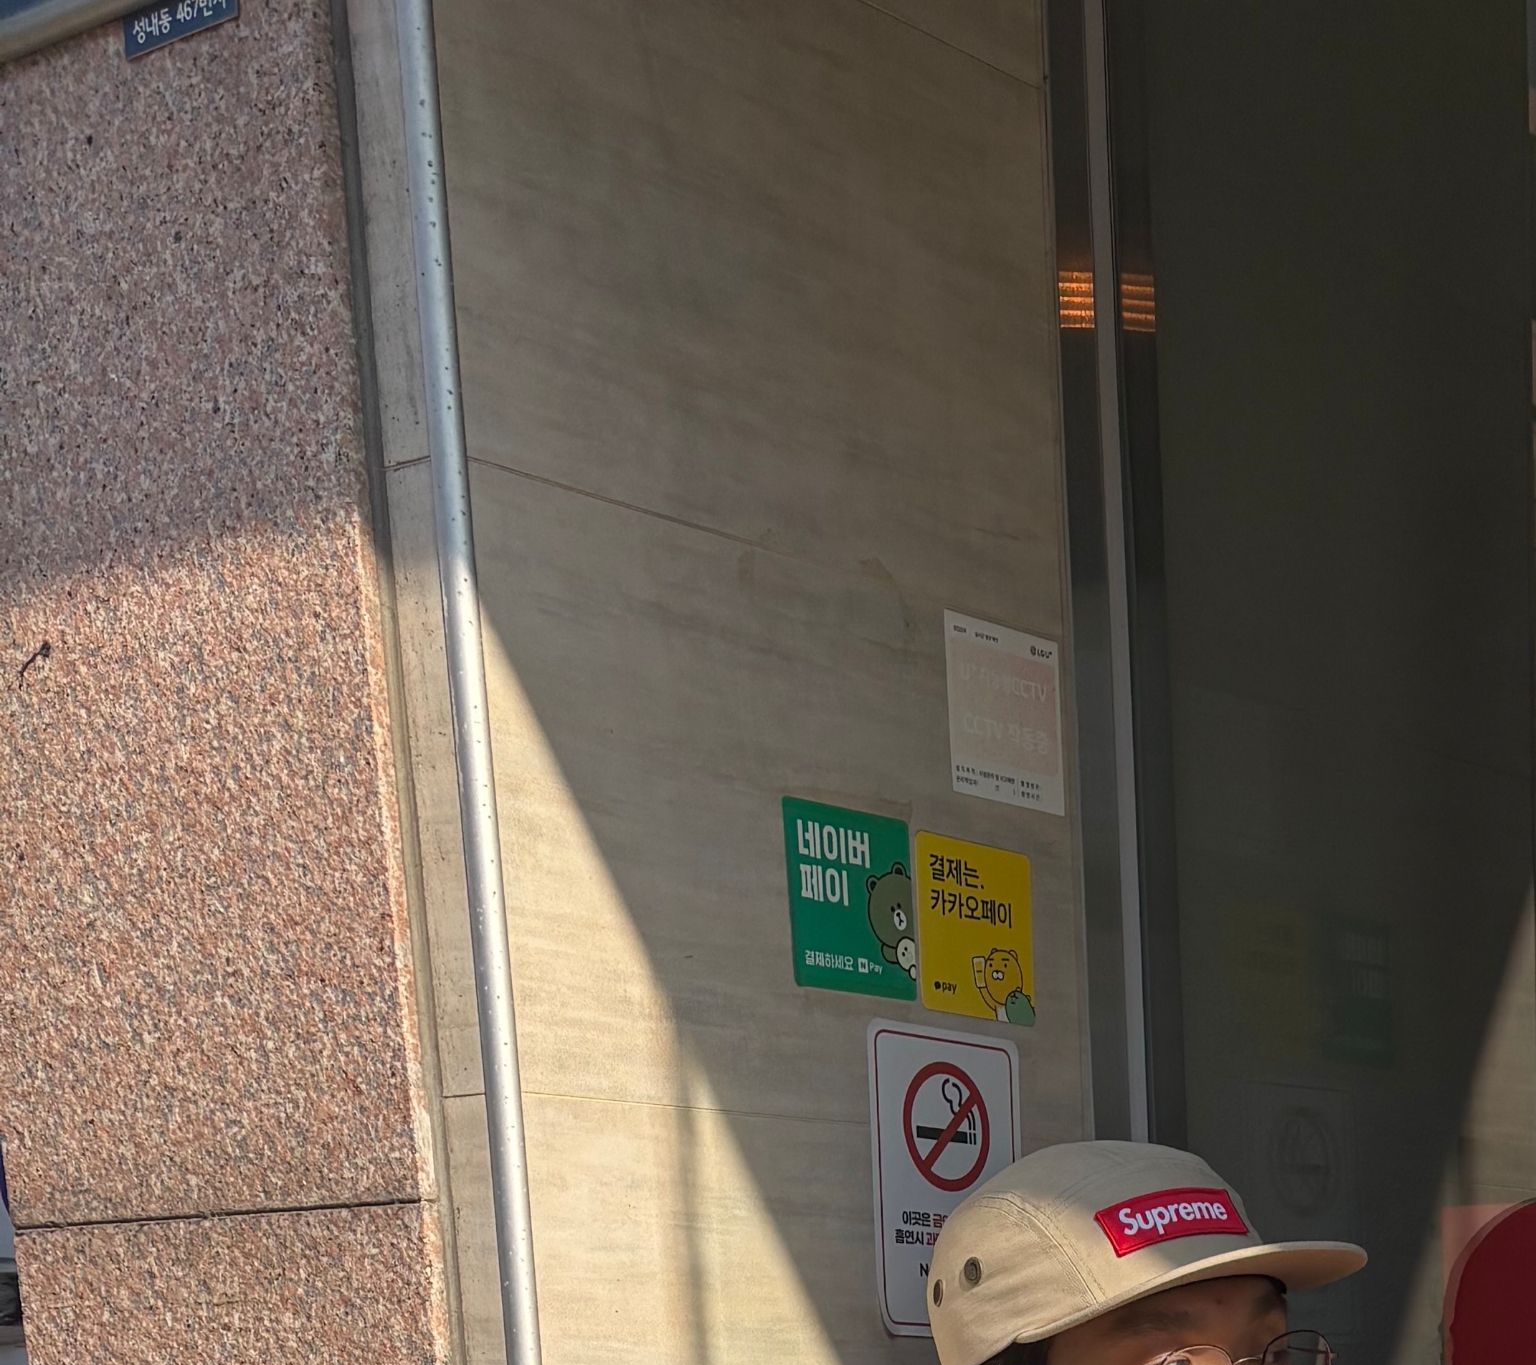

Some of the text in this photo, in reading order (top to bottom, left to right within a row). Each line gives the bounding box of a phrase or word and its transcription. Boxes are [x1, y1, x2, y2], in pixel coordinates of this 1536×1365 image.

[132, 7, 172, 44] 성내동
[796, 818, 871, 869] 네이버
[799, 862, 849, 907] 페이
[929, 853, 985, 890] 결제는.
[930, 888, 1012, 929] 카카오페이
[804, 949, 854, 972] 결제하세요
[941, 982, 957, 995] pay
[902, 1210, 948, 1229] 이곳은 금
[1118, 1201, 1228, 1236] Supreme
[894, 1228, 925, 1246] 흡연시
[919, 1262, 931, 1278] N
